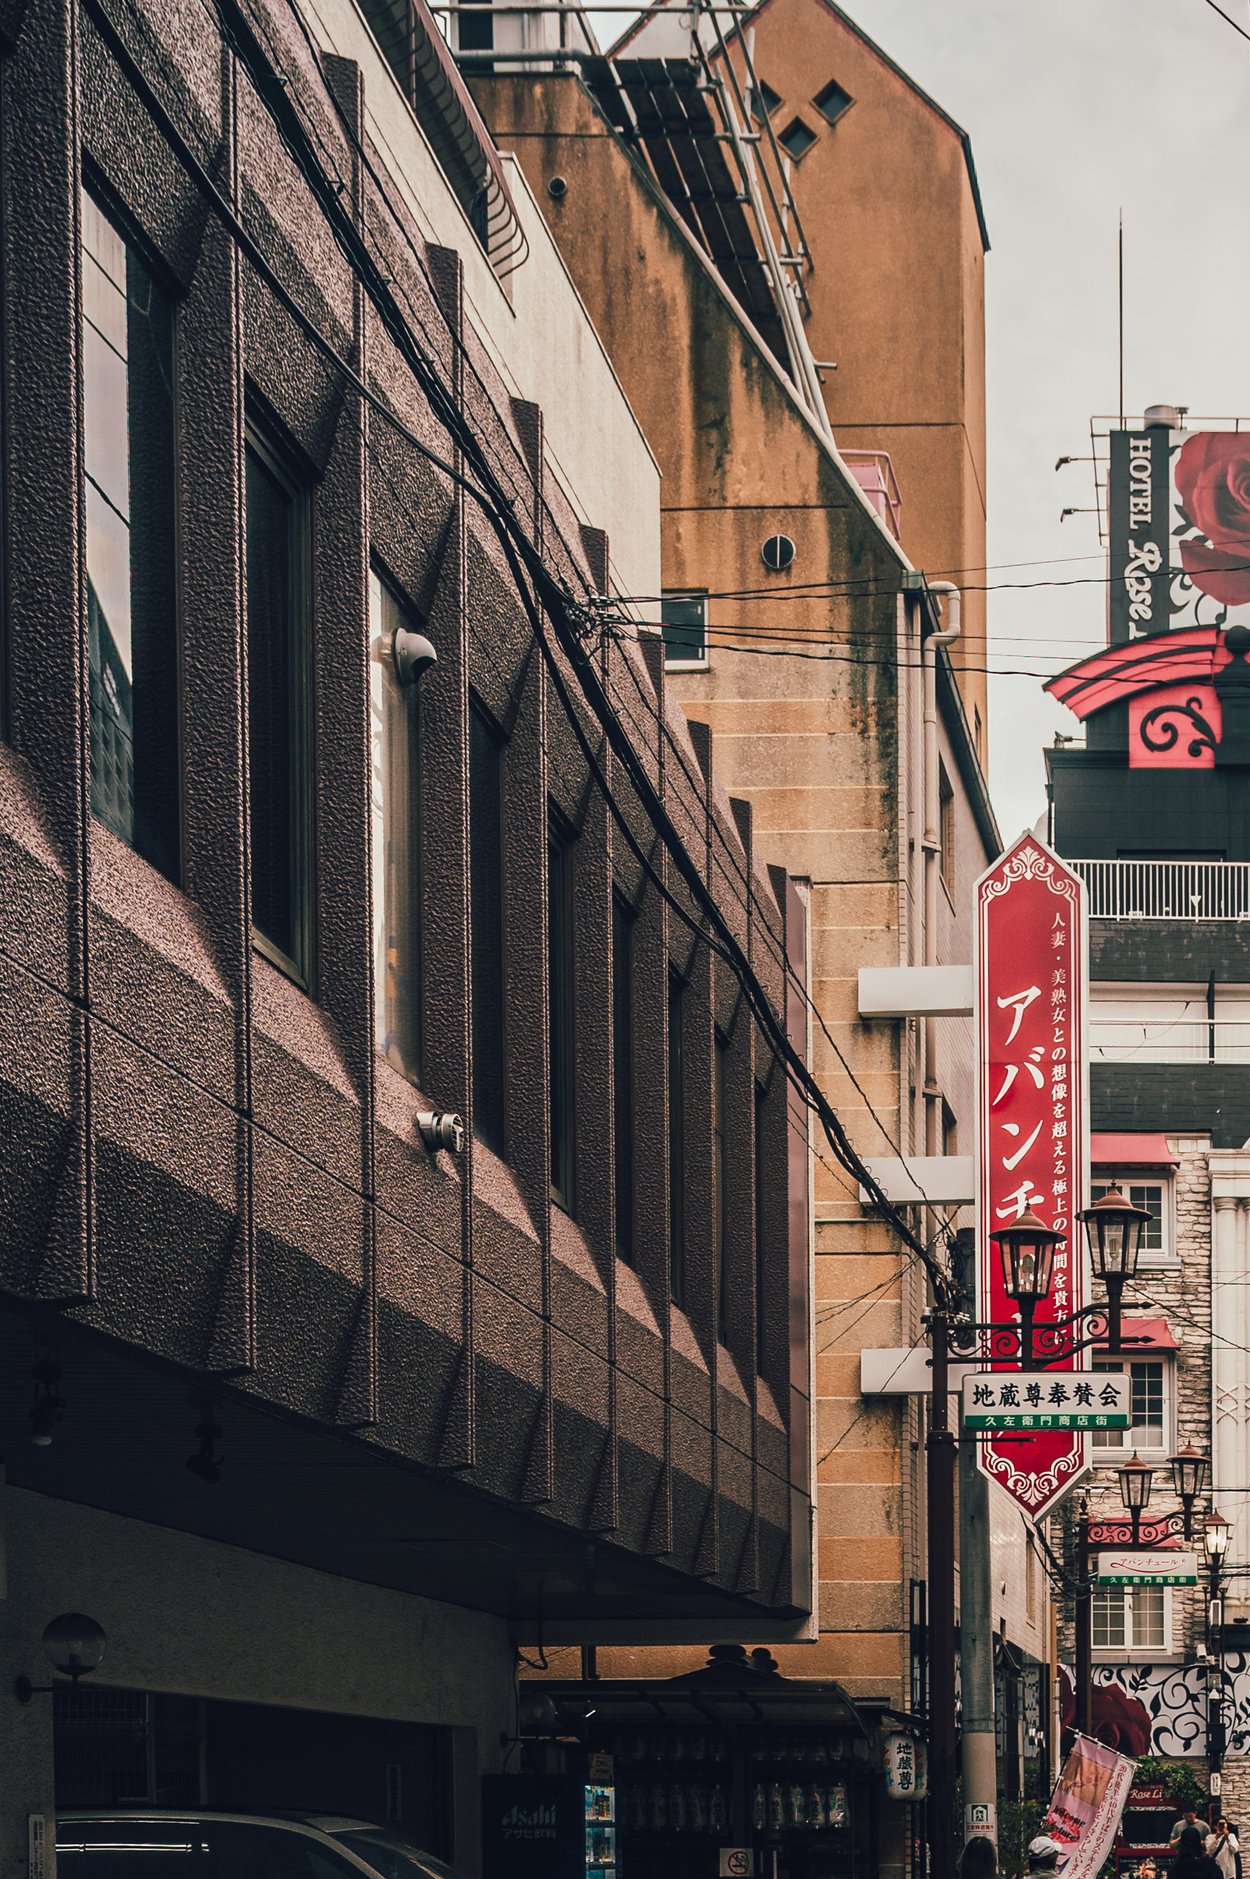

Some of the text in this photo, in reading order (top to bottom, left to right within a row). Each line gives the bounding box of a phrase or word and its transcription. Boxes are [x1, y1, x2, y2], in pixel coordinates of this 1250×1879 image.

[1123, 437, 1161, 622] HOTEL Rose
[972, 1381, 1122, 1409] 地蔵尊奉賛会
[985, 1414, 1109, 1427] 久左衛門商店街
[1109, 1576, 1187, 1584] 久左衛門商店街
[896, 1742, 913, 1790] 地蔵尊
[1130, 1788, 1151, 1800] Rose
[501, 1803, 558, 1826] Asahi
[502, 1828, 557, 1839] アサヒ飲料
